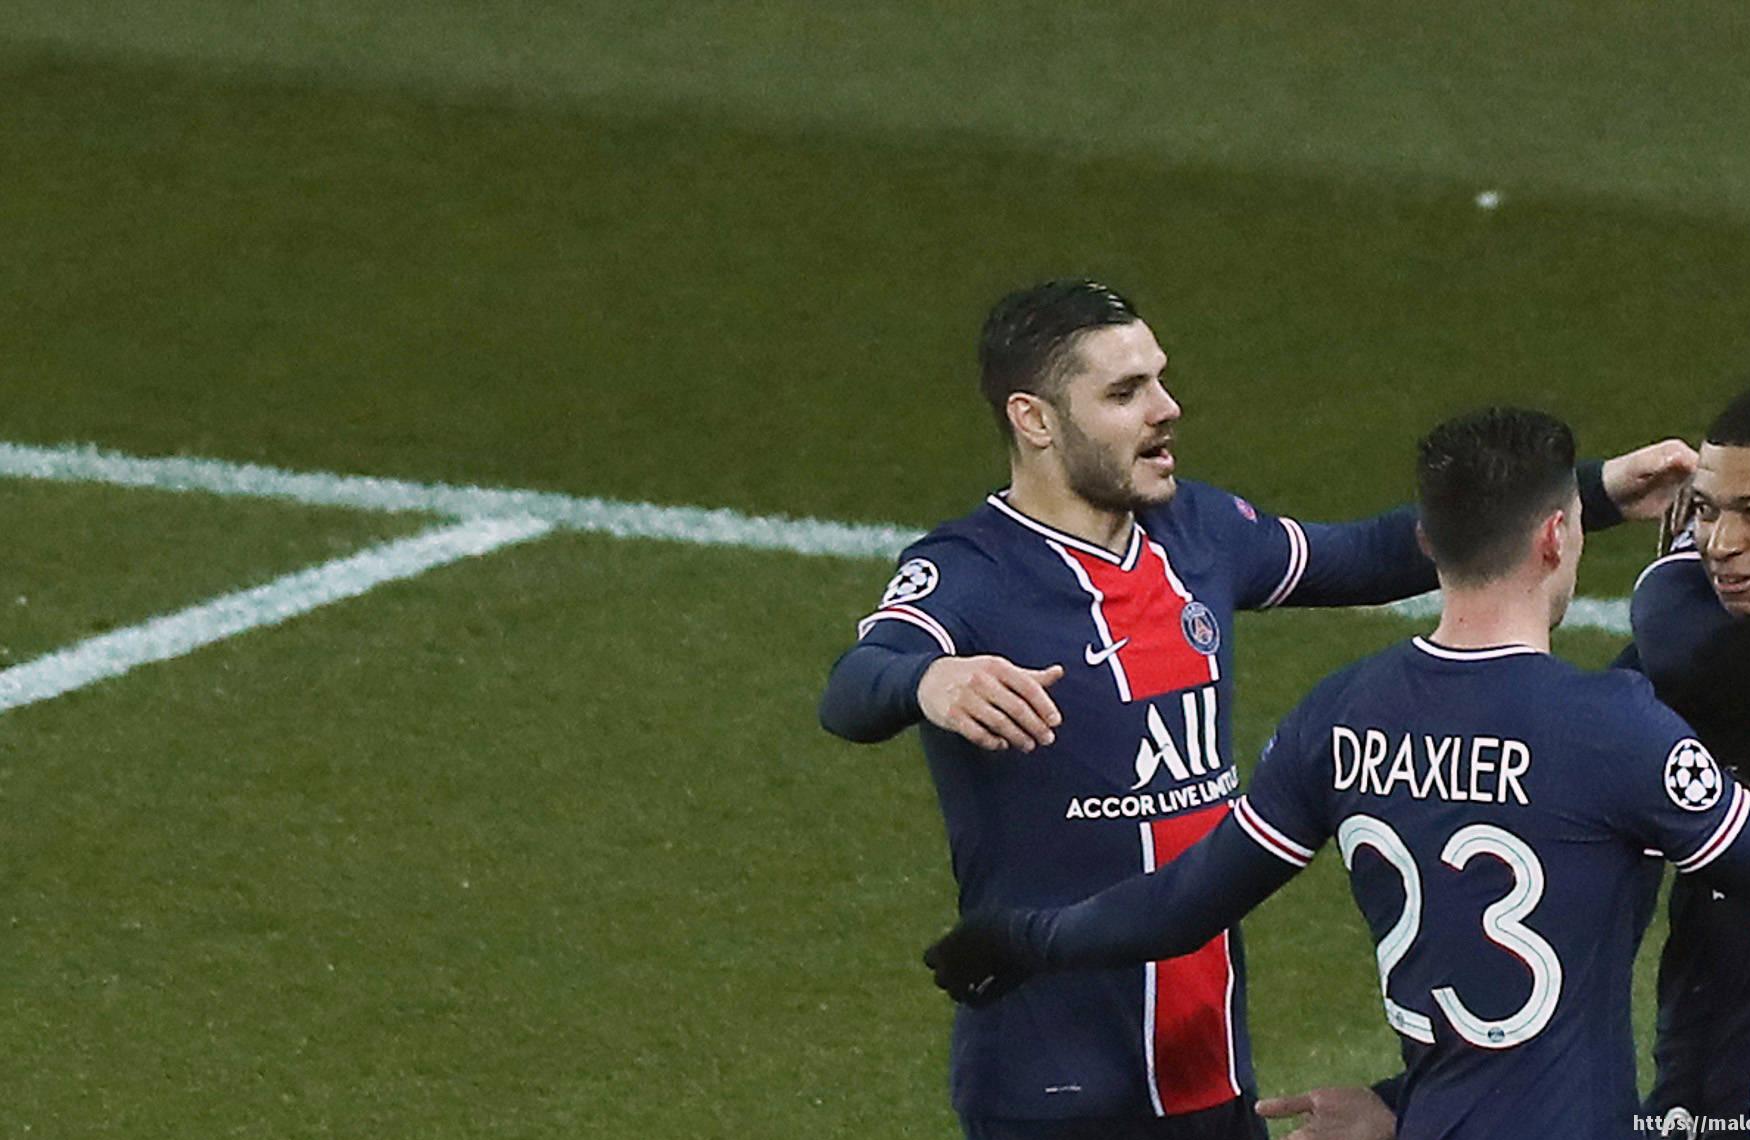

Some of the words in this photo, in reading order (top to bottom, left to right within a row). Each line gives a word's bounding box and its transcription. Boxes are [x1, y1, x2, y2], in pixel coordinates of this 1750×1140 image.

[1066, 794, 1157, 819] ACCOR
[1158, 784, 1201, 813] LIVE
[1332, 726, 1530, 805] DRAXLER
[1337, 814, 1562, 1049] 23
